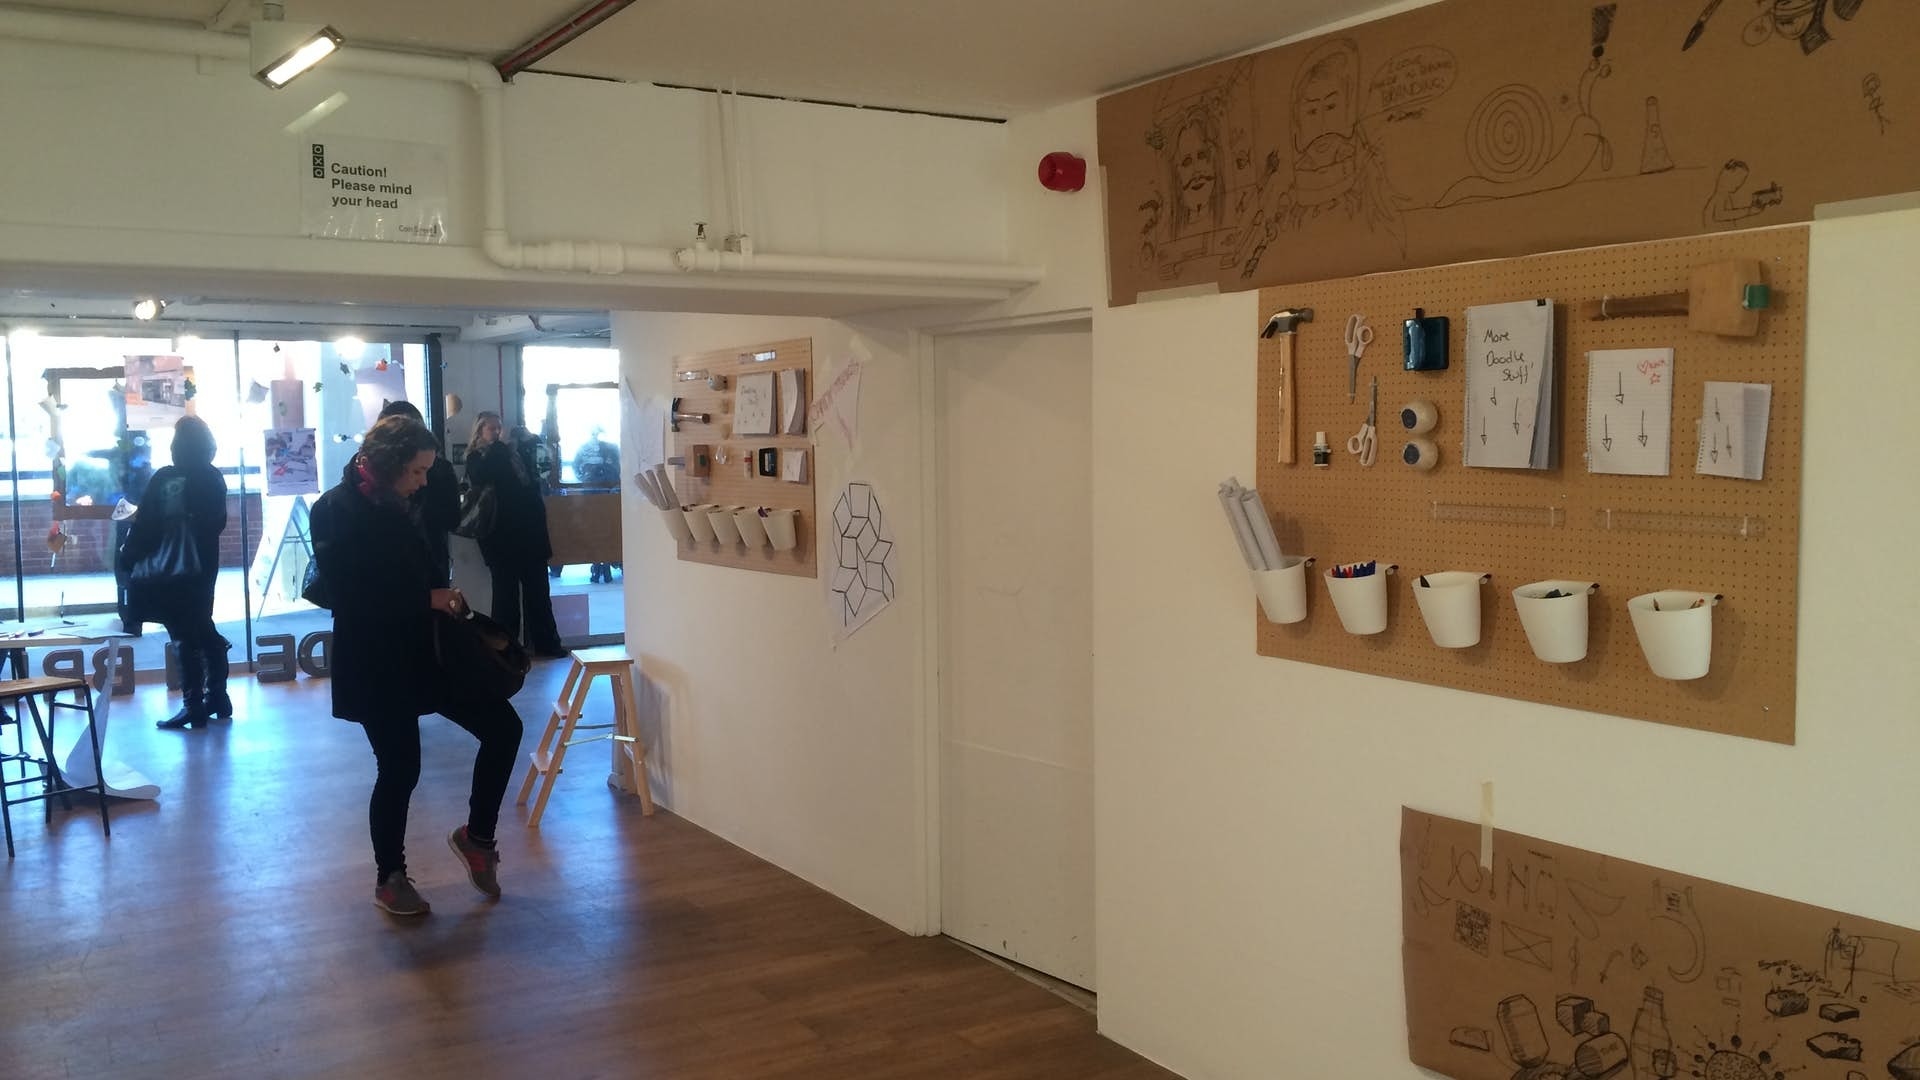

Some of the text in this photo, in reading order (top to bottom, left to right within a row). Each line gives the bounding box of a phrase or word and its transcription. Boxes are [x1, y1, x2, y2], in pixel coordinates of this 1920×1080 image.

[331, 163, 388, 178] Caution!
[331, 179, 413, 195] Please mind
[332, 196, 399, 209] your head
[1484, 329, 1511, 343] More
[1486, 350, 1525, 367] Doodle
